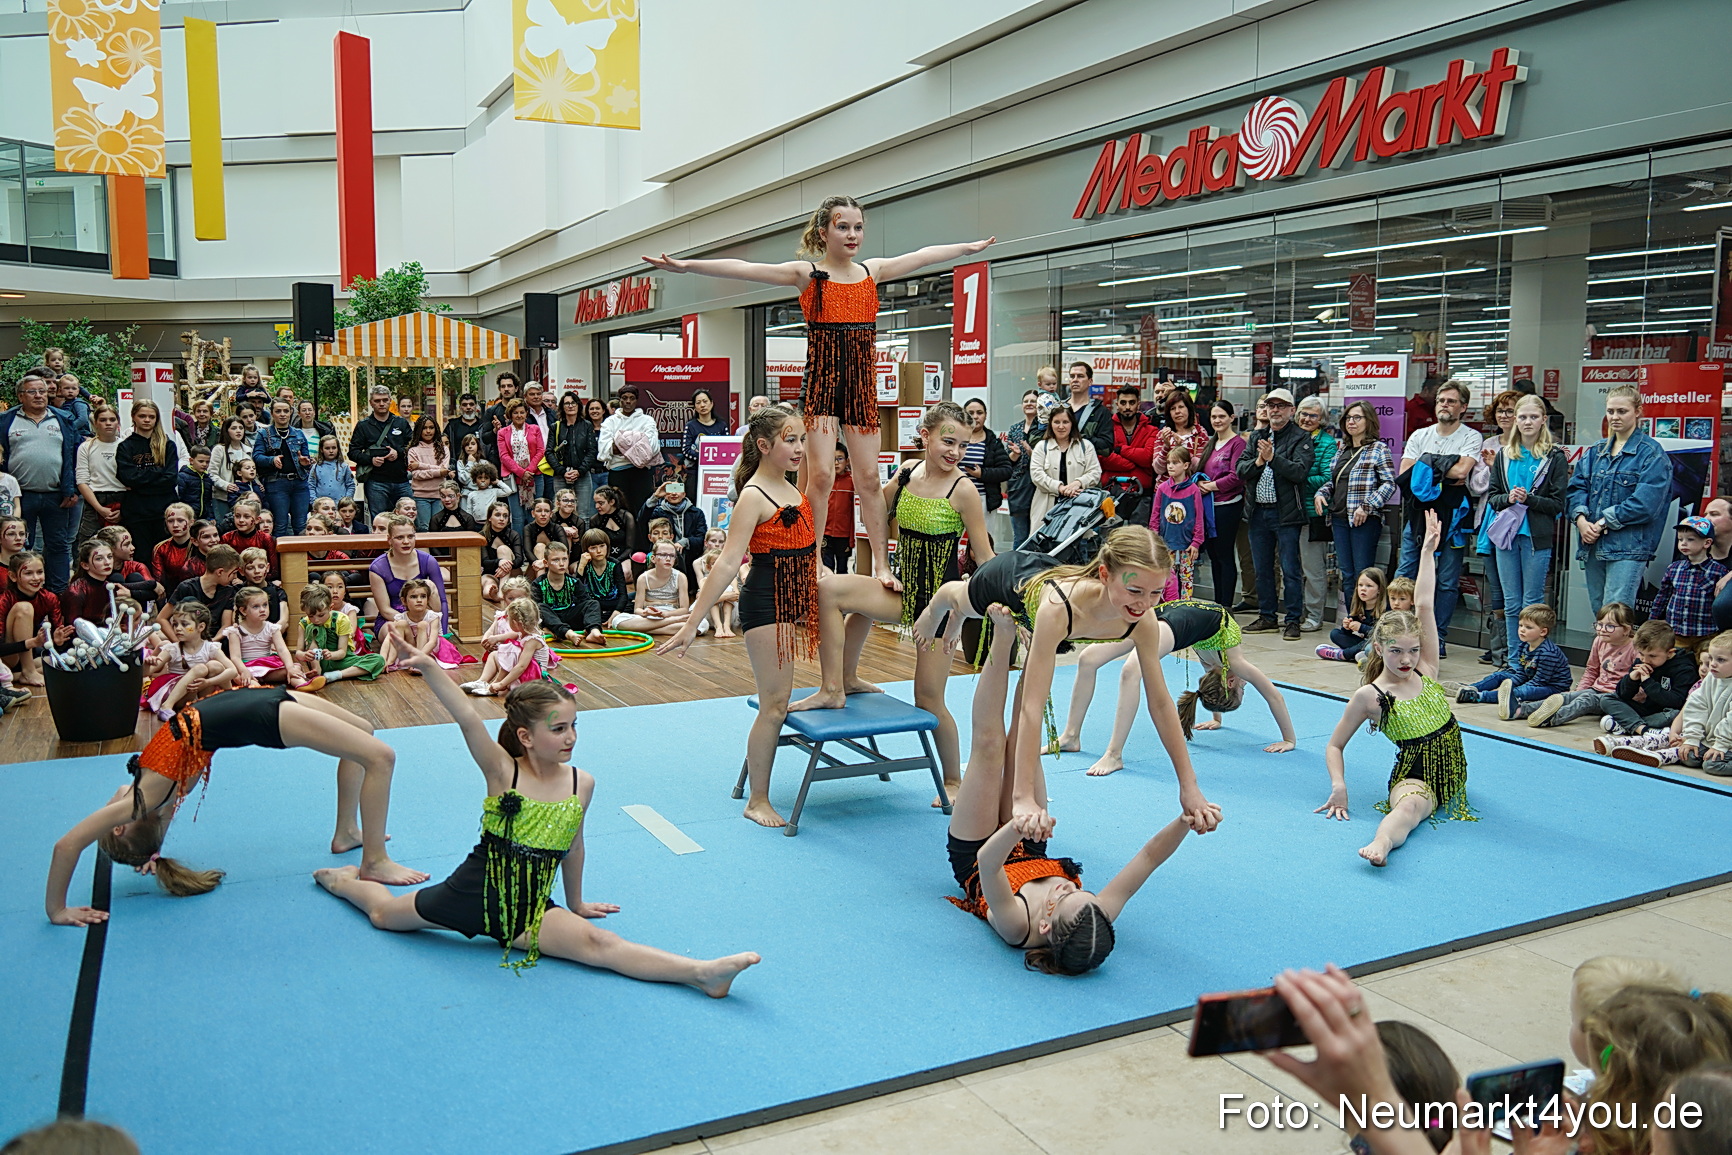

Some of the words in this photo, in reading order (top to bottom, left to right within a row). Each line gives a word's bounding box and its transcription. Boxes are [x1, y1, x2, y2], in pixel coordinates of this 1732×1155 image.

[963, 272, 980, 334] 1
[959, 339, 981, 352] Stunde
[1602, 343, 1671, 360] Smartbar
